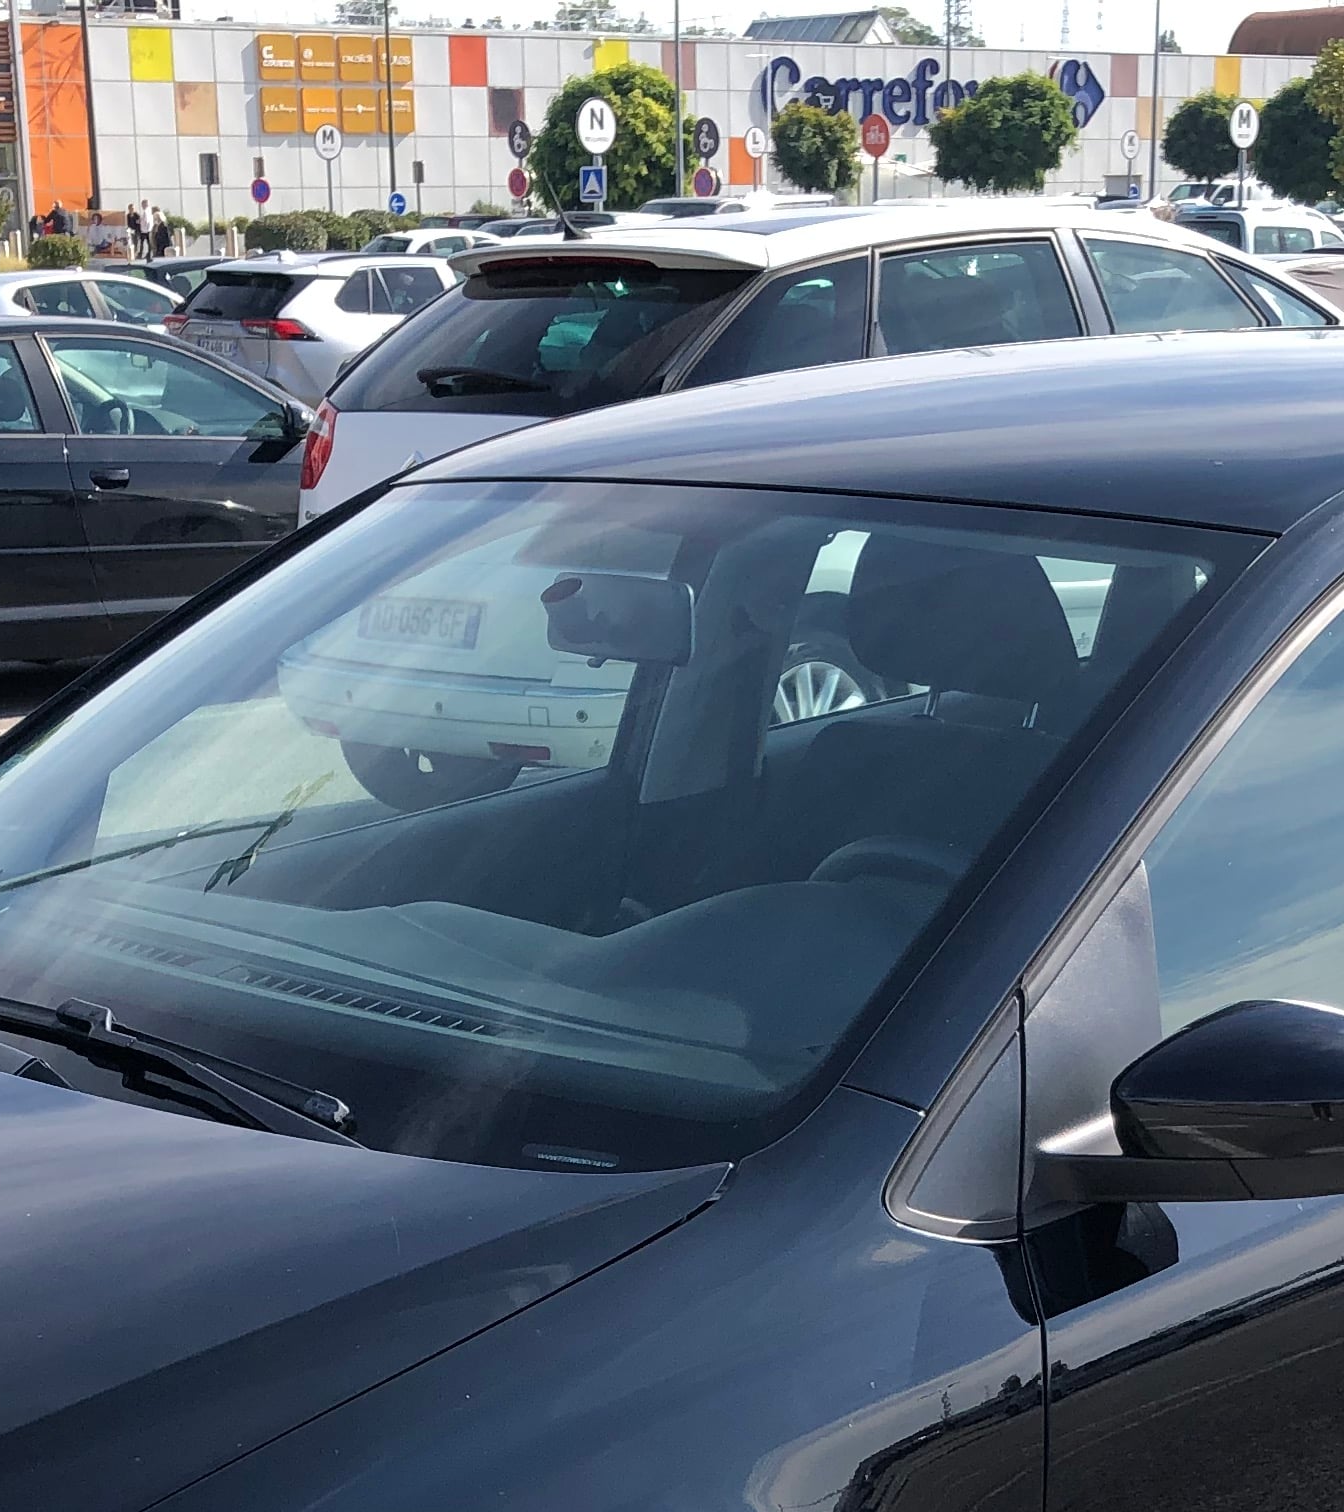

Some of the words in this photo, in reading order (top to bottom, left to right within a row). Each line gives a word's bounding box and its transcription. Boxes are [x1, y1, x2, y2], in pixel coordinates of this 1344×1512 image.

[761, 56, 979, 126] Crrefo
[590, 108, 604, 130] N
[1238, 109, 1251, 128] M
[322, 130, 335, 144] M
[751, 132, 760, 145] L
